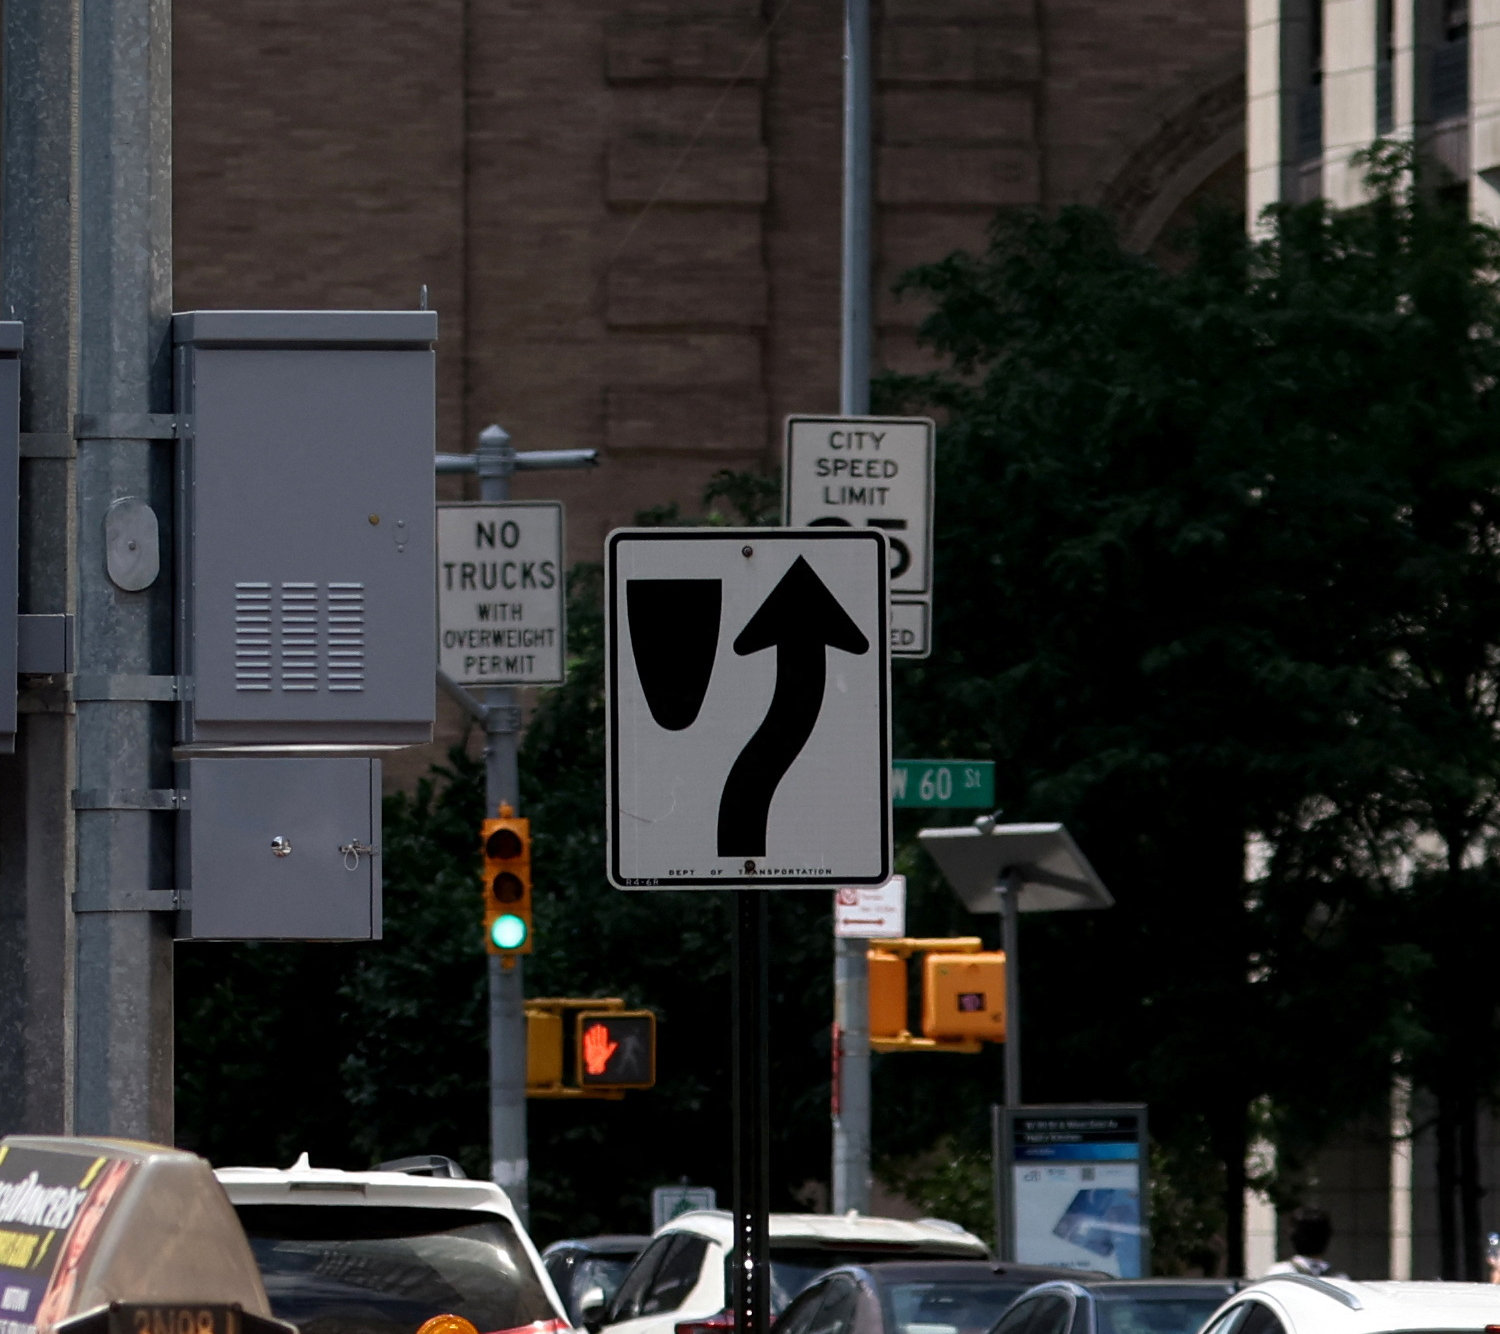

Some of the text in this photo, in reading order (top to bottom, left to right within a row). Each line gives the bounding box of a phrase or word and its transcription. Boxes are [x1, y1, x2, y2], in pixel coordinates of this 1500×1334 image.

[829, 431, 886, 450] CITY
[816, 458, 899, 478] SPEED
[823, 486, 889, 505] LIMIT
[476, 521, 520, 548] NO
[443, 561, 555, 591] TRUCKS
[477, 603, 522, 621] WITH
[443, 629, 556, 649] OVERWEIGHT
[464, 655, 535, 674] PERMIT
[891, 767, 981, 800] W 60 St
